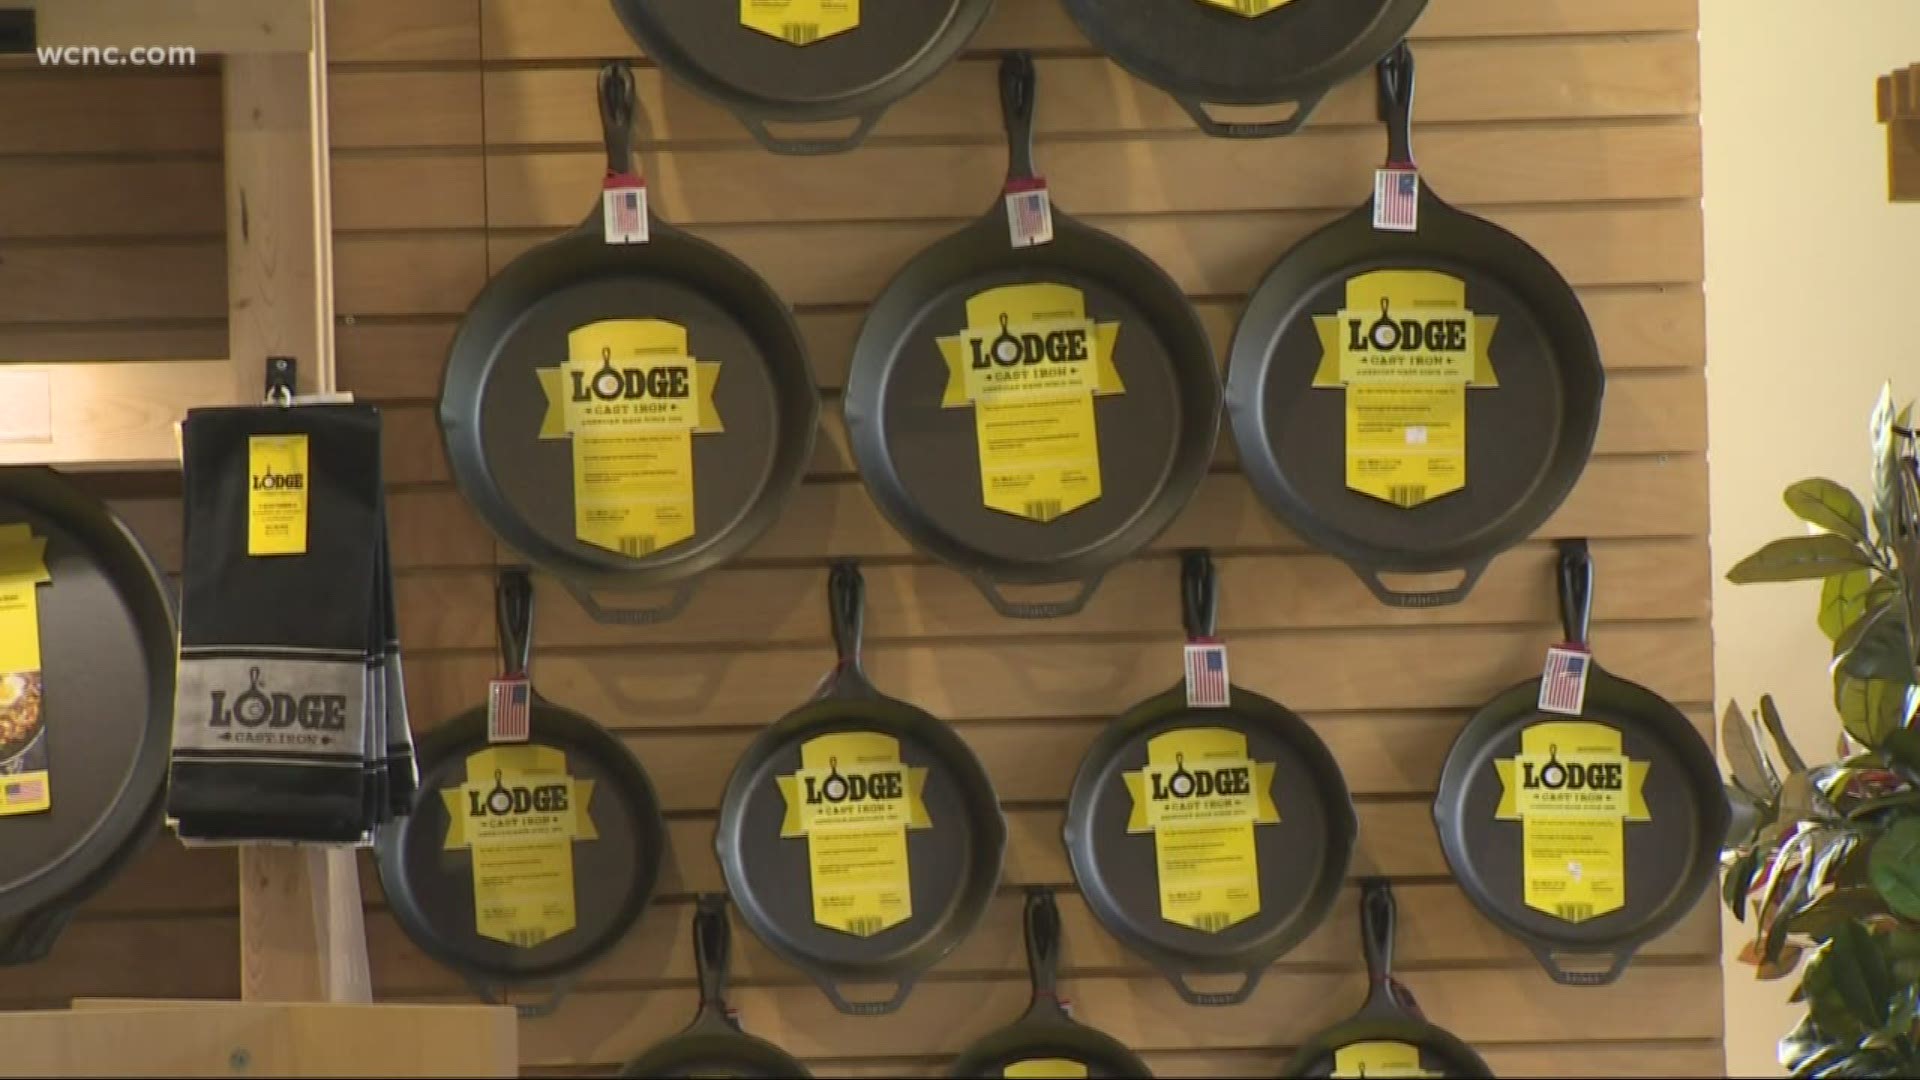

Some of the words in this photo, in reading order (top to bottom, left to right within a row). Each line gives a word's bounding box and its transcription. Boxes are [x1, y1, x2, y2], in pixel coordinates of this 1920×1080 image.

[970, 312, 1088, 370] LODGE
[1348, 296, 1466, 351] LODGE
[571, 347, 690, 402] LODGE
[595, 405, 629, 415] CAST
[634, 403, 667, 413] IRON
[209, 666, 346, 730] LODGE
[235, 733, 273, 745] CAST
[280, 733, 316, 745] IRON
[805, 756, 903, 804] LODGE
[1152, 752, 1250, 800] LODGE
[1523, 743, 1622, 790] LODGE
[469, 768, 568, 817] LODGE
